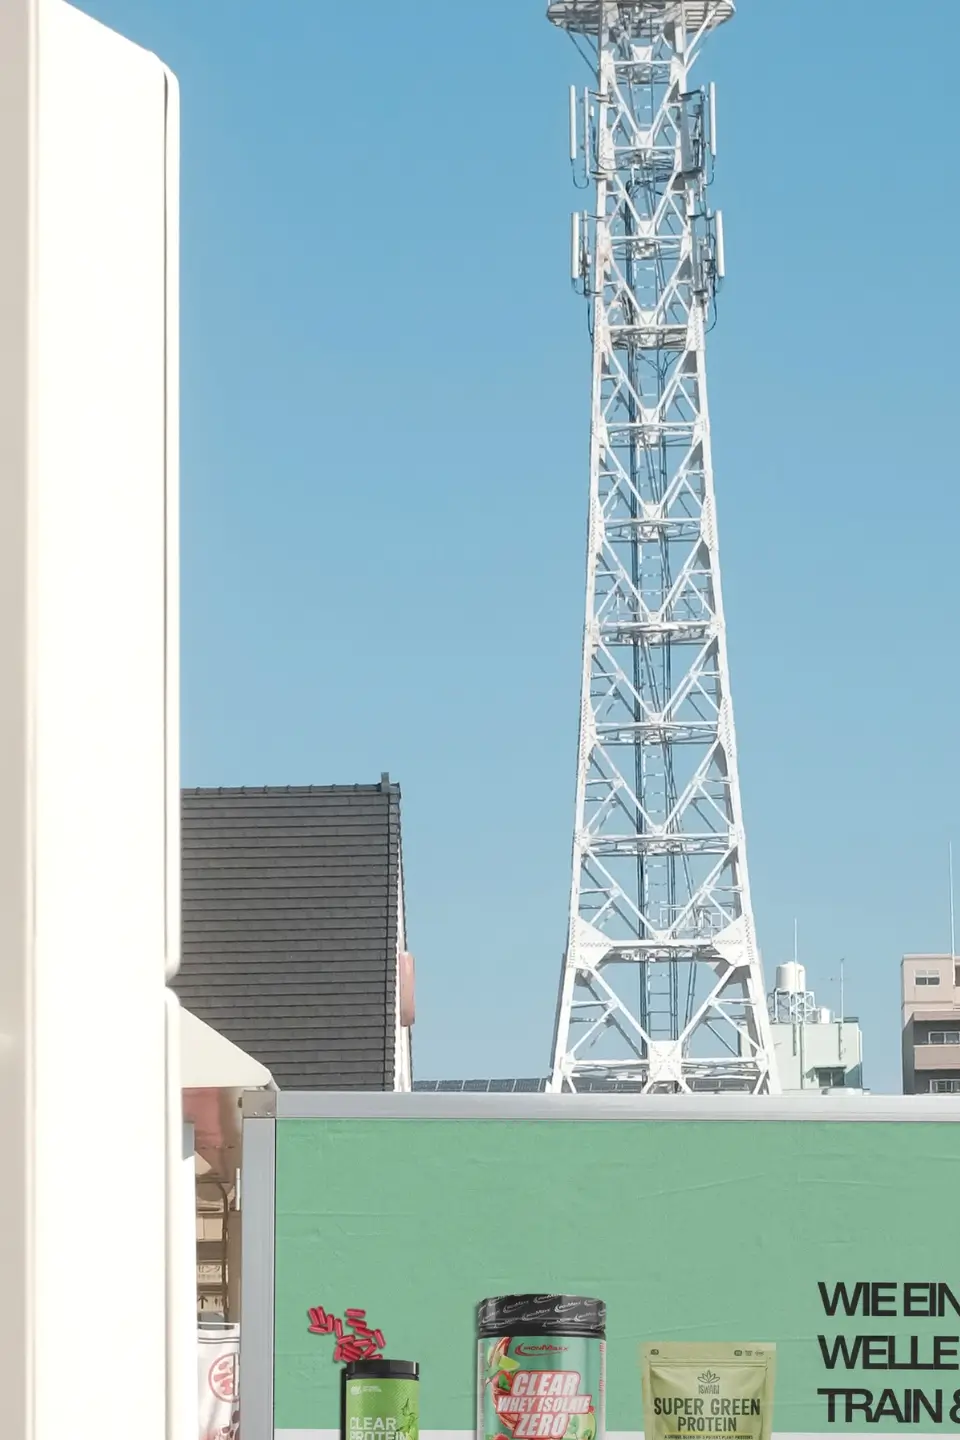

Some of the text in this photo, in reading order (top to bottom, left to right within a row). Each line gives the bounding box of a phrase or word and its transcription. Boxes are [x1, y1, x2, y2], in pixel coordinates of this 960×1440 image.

[817, 1281, 897, 1316] WIE
[817, 1335, 960, 1370] WELLE
[513, 1373, 579, 1396] CLEAR
[498, 1395, 591, 1413] WHEY ISOLATE
[654, 1397, 761, 1416] SUPER GREEN
[817, 1388, 943, 1423] TRAIN
[349, 1417, 397, 1431] CLEAR
[515, 1413, 566, 1436] ZERO
[677, 1416, 737, 1432] PROTEIN
